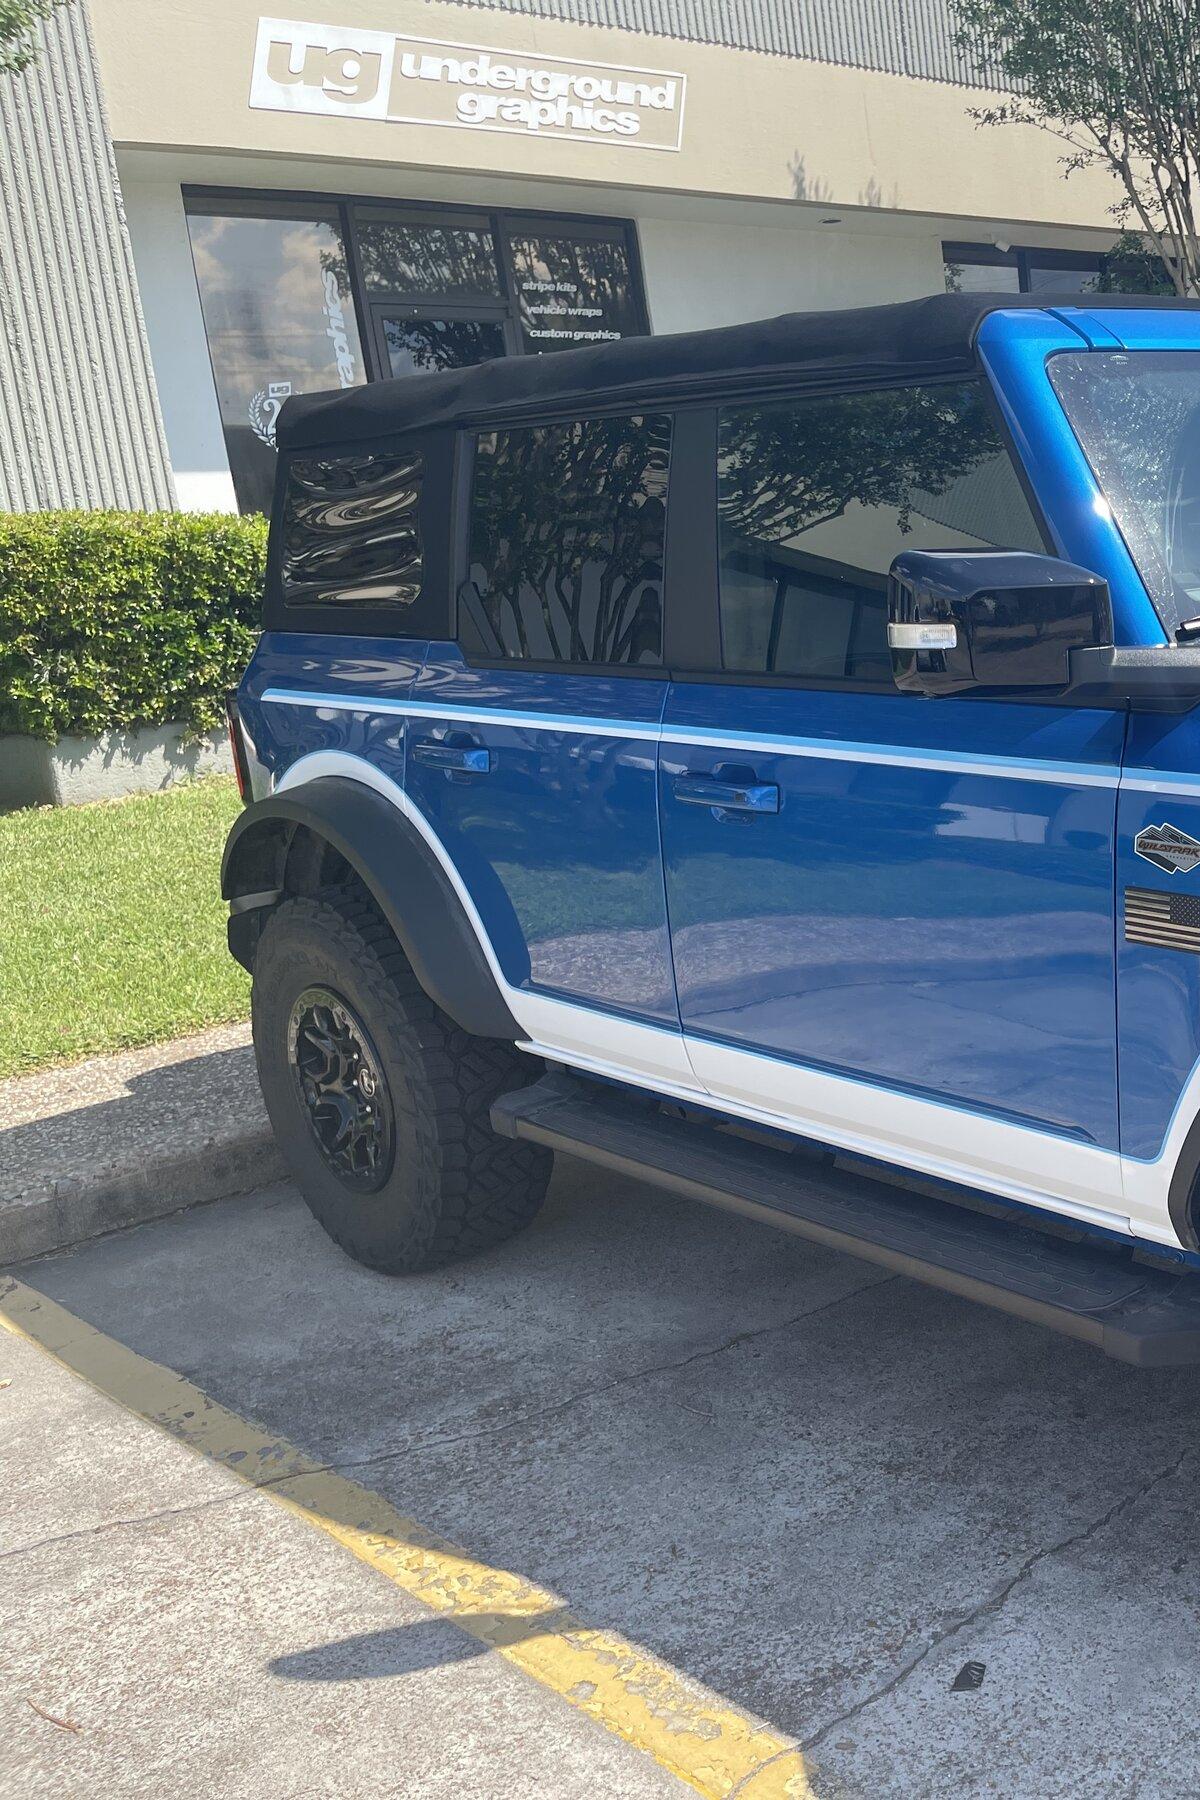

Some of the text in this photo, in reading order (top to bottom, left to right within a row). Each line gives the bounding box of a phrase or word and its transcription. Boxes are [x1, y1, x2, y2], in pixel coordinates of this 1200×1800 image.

[266, 40, 383, 104] ug
[400, 50, 677, 110] underground
[456, 92, 640, 135] graphics
[522, 281, 577, 292] stripe kits
[321, 267, 356, 388] raphics
[527, 305, 603, 318] vehicle wraps
[529, 329, 621, 341] custom graphics
